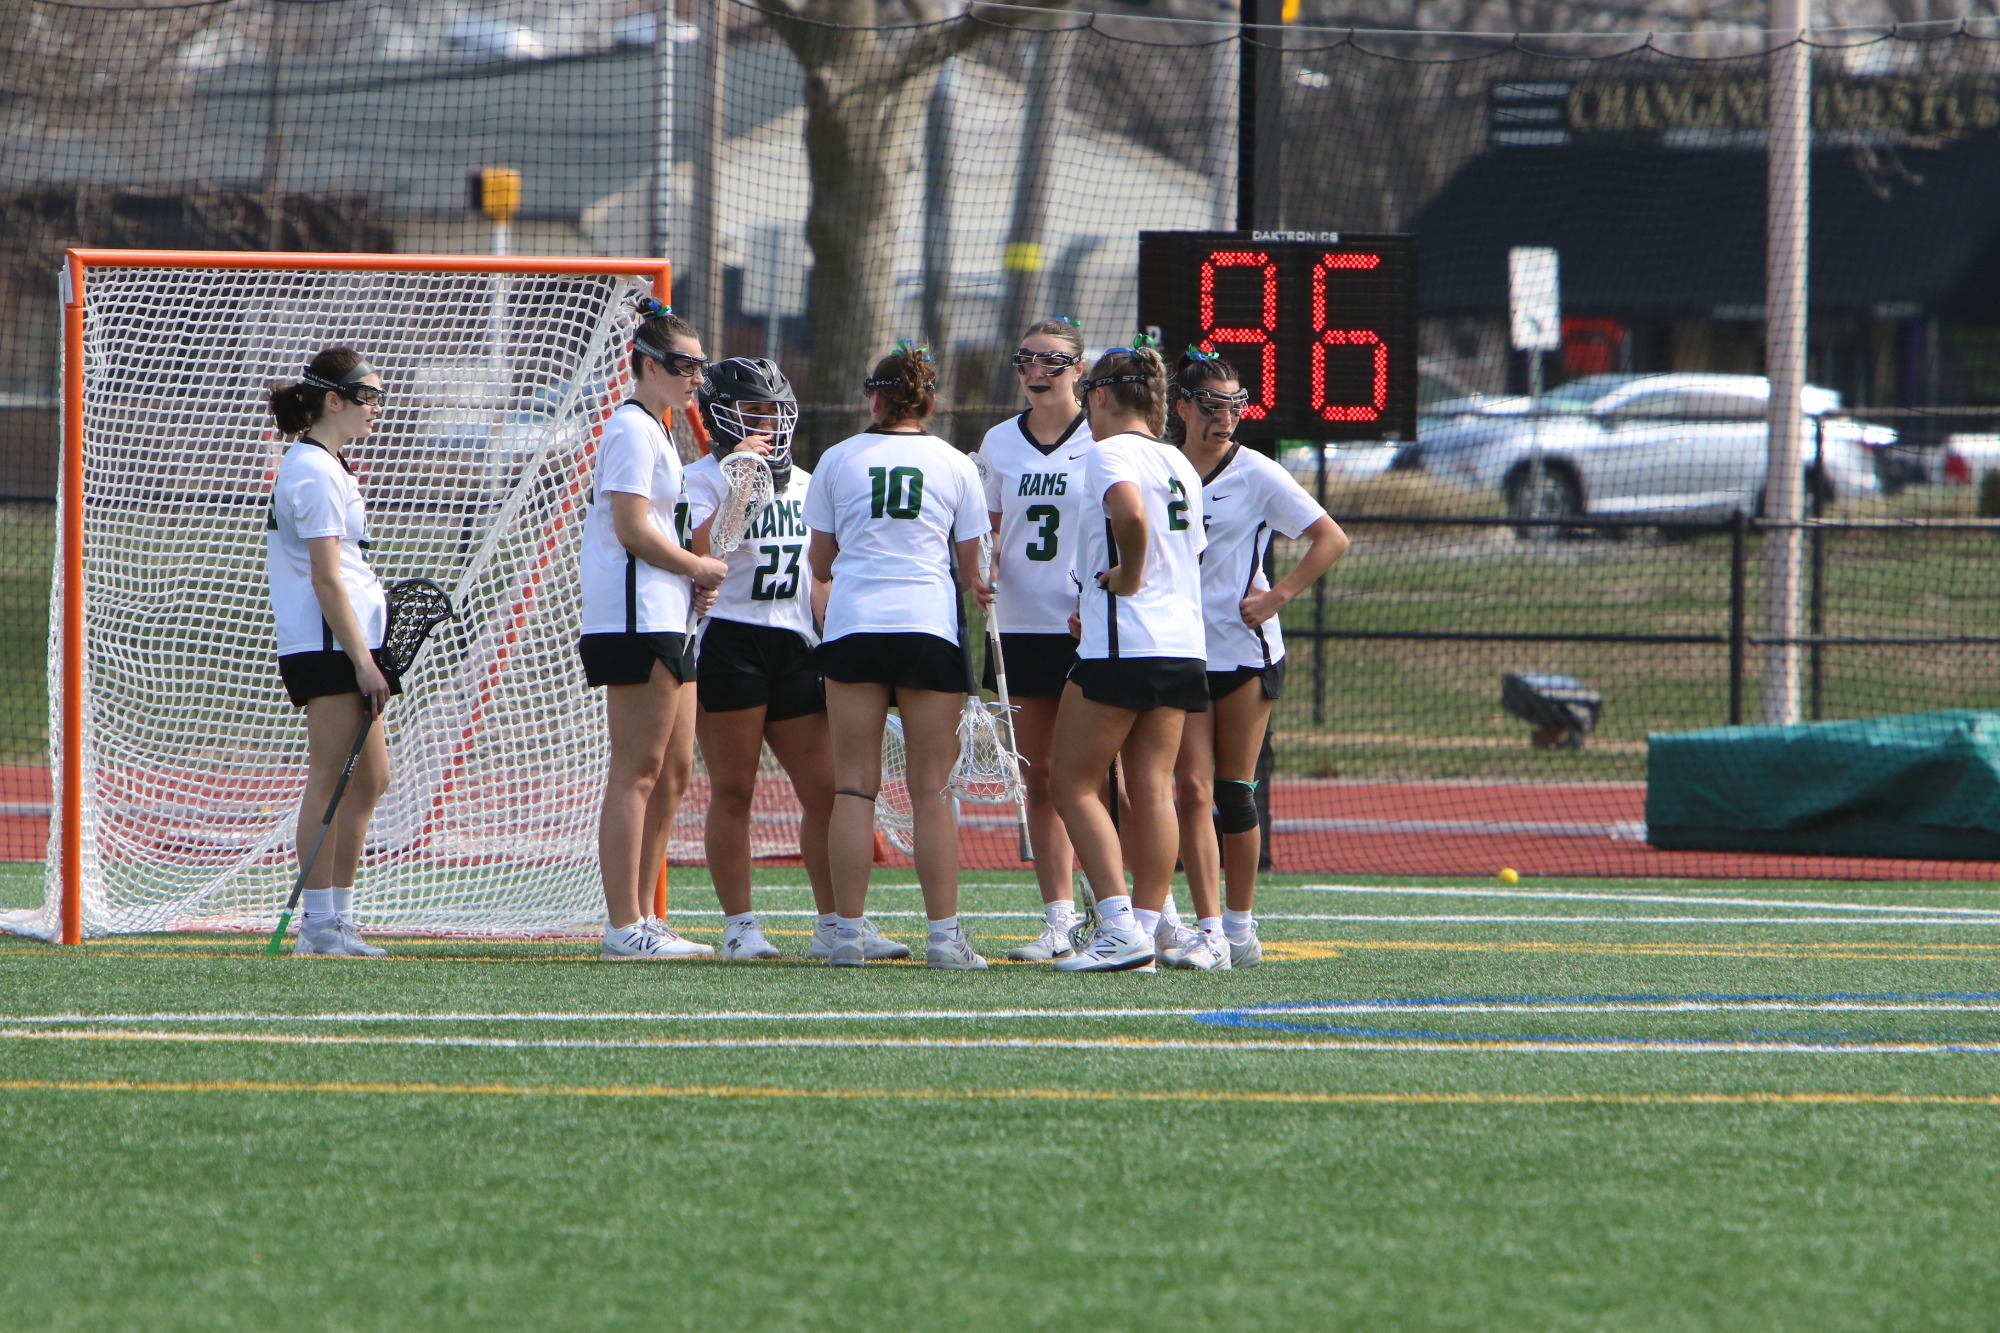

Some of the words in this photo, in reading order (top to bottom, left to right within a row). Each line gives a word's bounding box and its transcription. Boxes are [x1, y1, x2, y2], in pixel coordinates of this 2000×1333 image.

[1252, 231, 1339, 243] DAKTRONICS
[869, 466, 924, 520] 10
[1018, 473, 1069, 496] RAMS
[1167, 476, 1190, 531] 2
[1026, 505, 1060, 562] 3
[751, 544, 803, 600] 23
